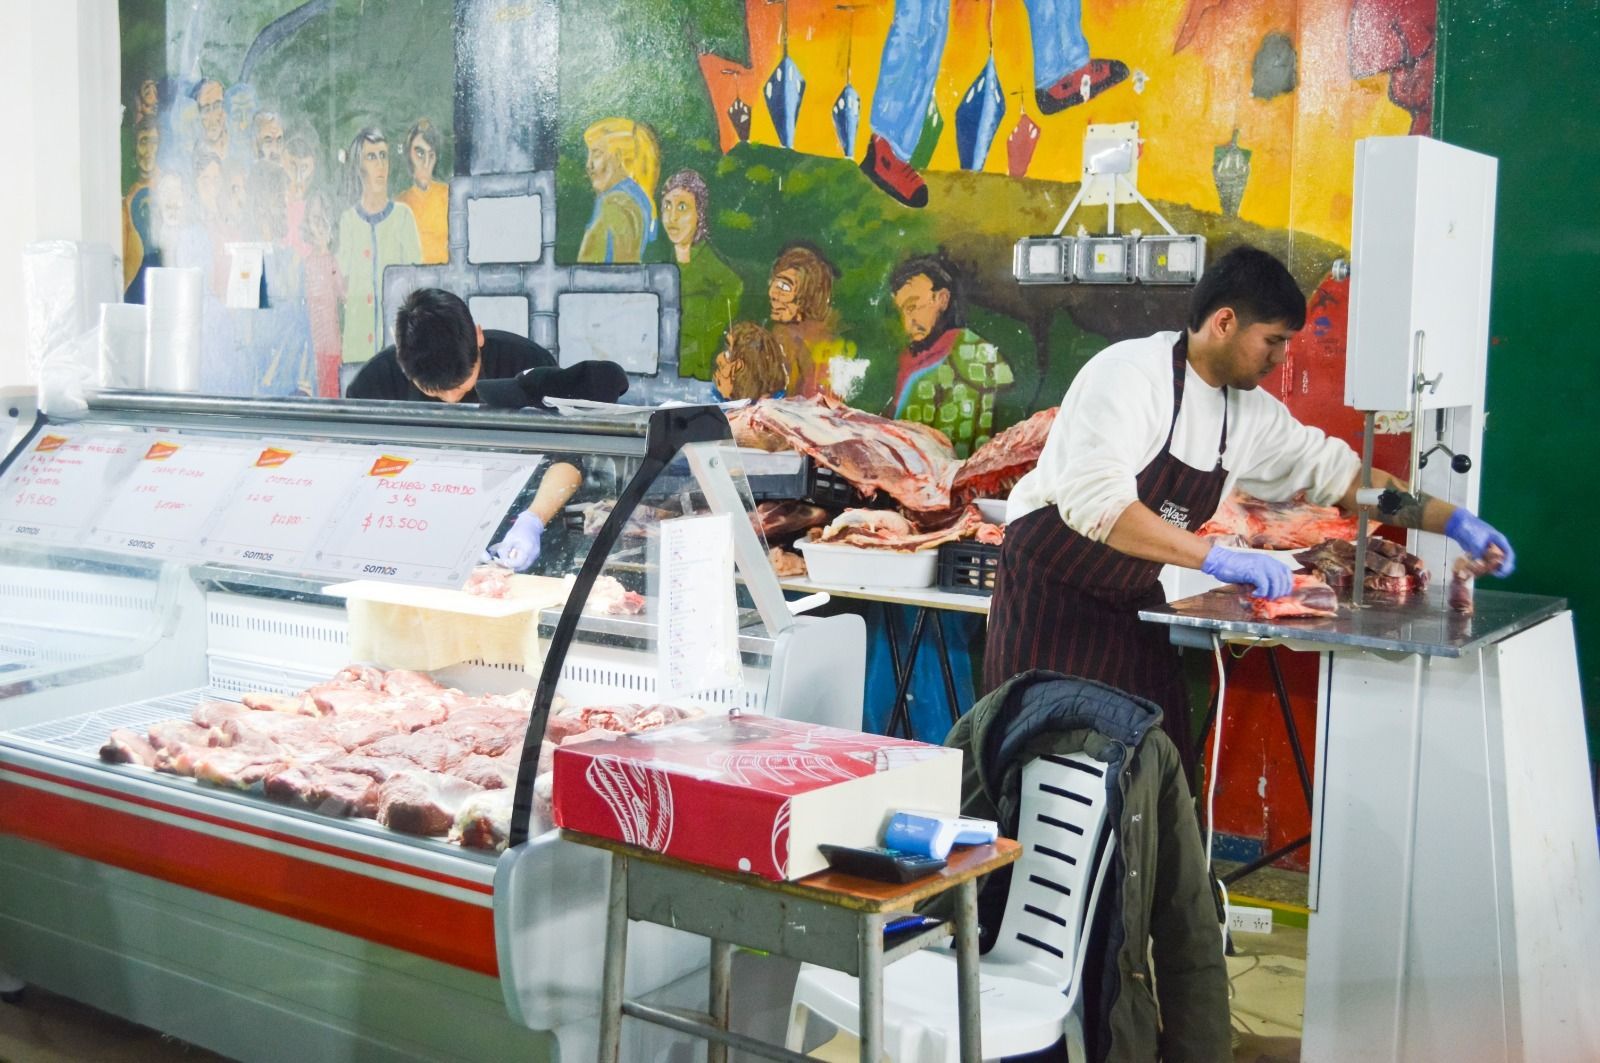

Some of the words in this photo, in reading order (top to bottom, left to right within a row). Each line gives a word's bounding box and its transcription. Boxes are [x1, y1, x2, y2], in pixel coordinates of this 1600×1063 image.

[387, 494, 399, 505] 3
[15, 526, 41, 536] somos
[127, 538, 156, 550] somos
[242, 549, 275, 562] somos
[362, 564, 398, 576] somos
